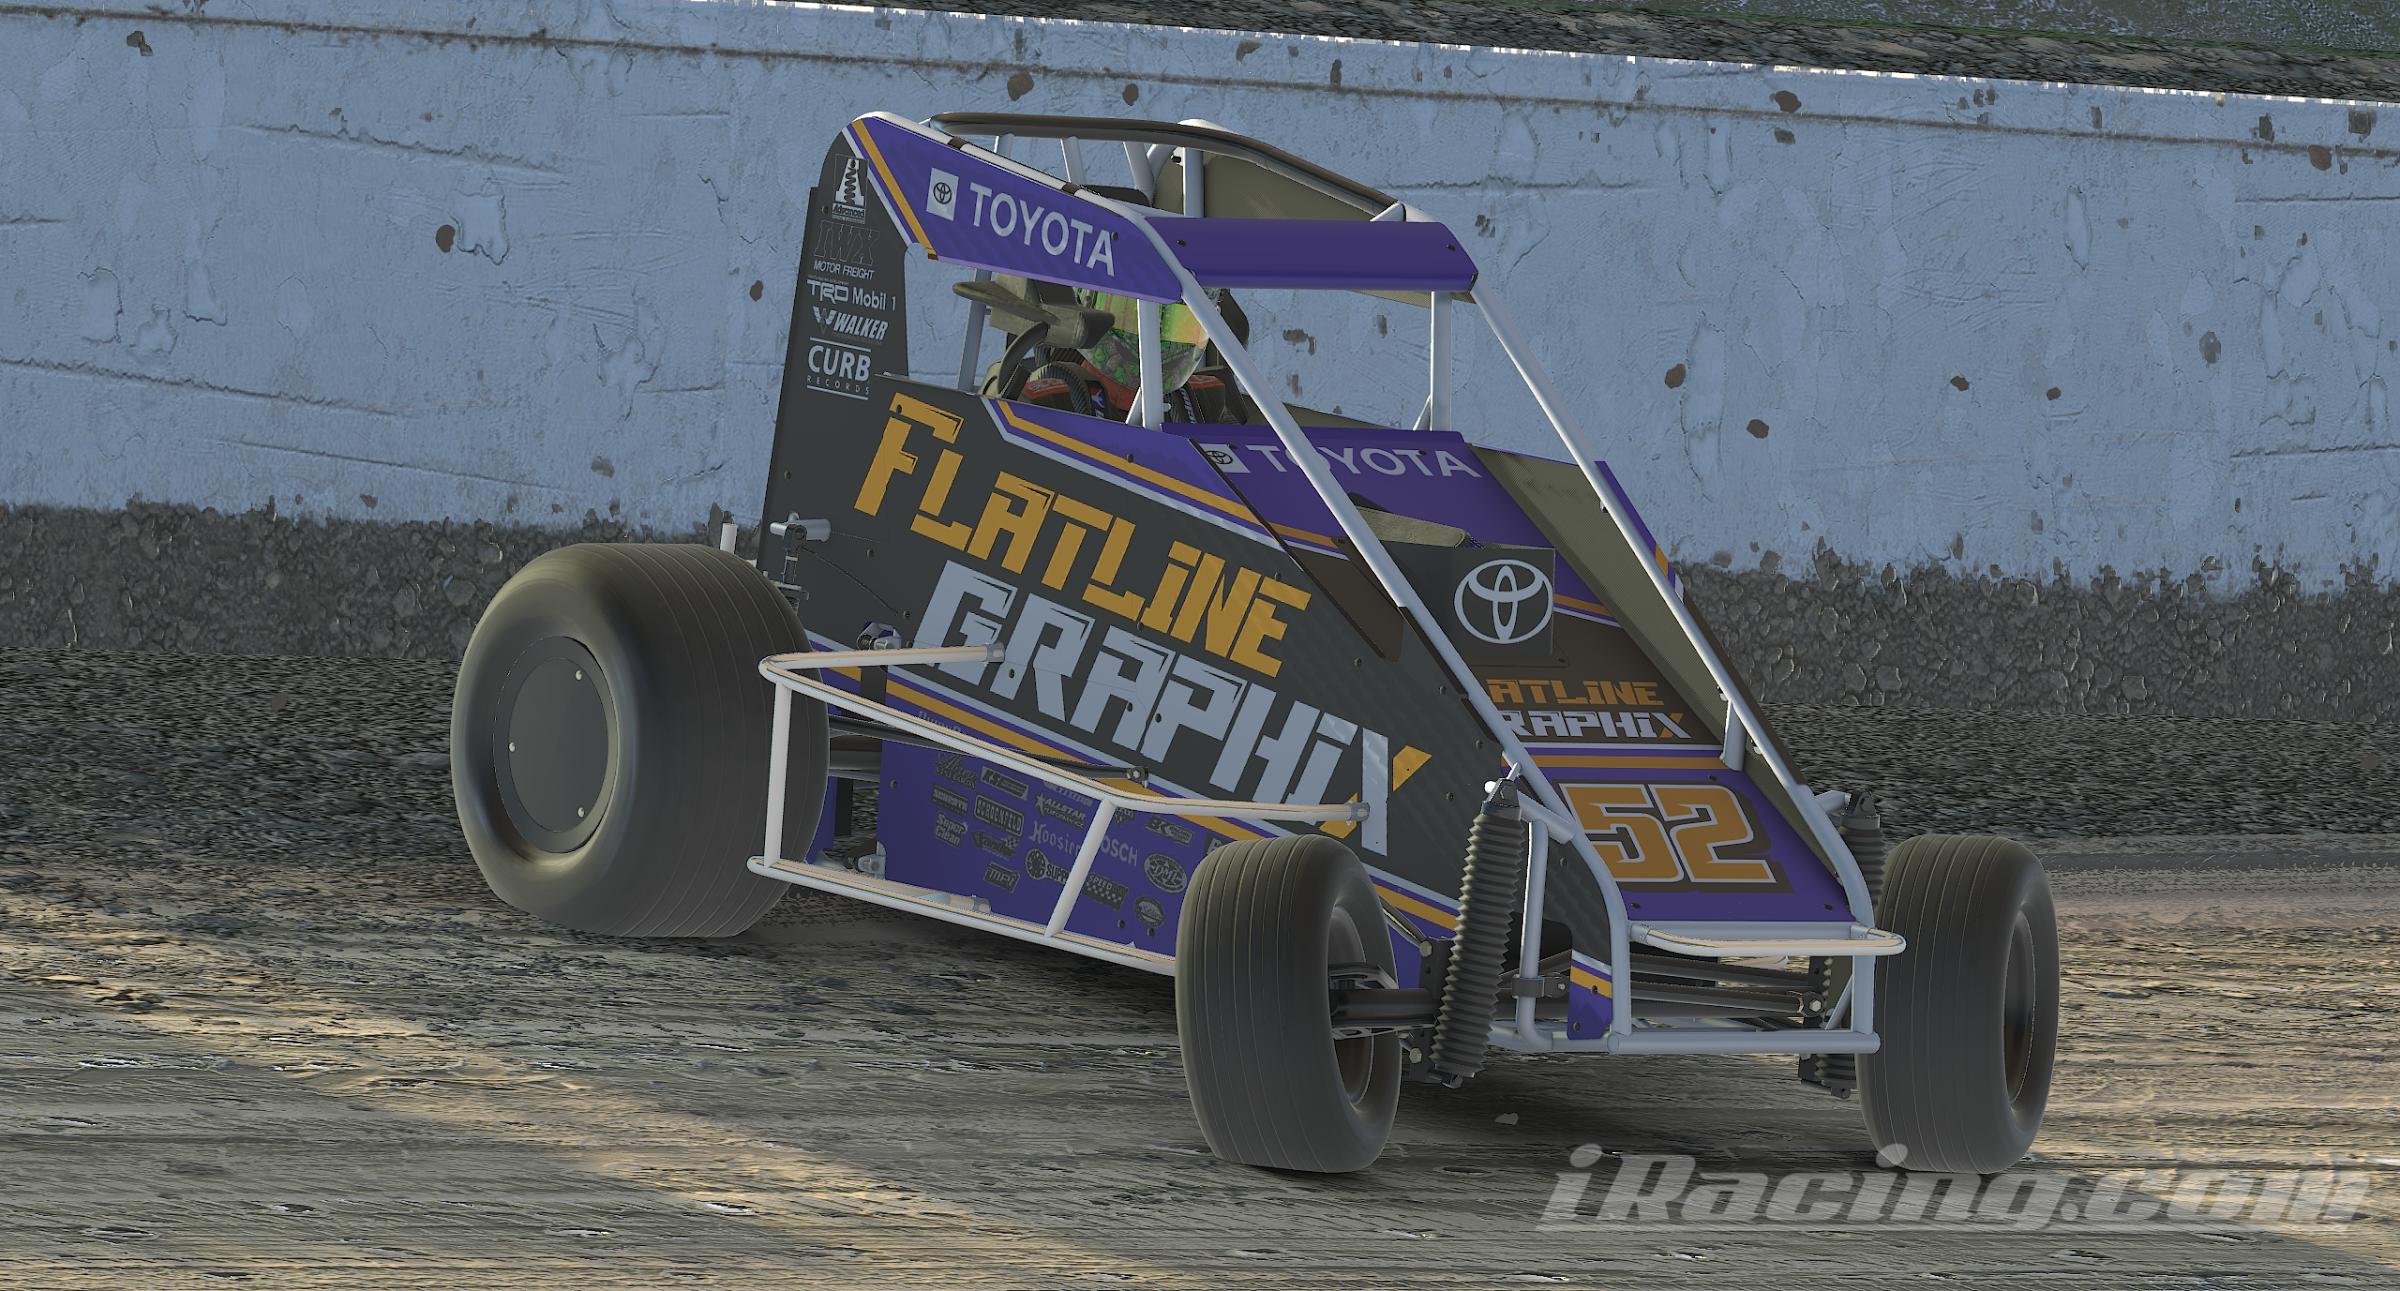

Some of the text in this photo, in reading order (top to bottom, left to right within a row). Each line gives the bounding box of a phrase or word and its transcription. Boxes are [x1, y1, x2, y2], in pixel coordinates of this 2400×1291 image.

[832, 204, 865, 219] Advanced
[969, 182, 1115, 276] TOYOTA
[813, 260, 841, 274] MOTOR
[843, 264, 875, 281] FREIGHT
[852, 286, 887, 311] Mobil
[886, 296, 896, 312] 1
[833, 312, 889, 341] WALKER
[808, 345, 871, 382] CURB
[806, 374, 870, 396] RECORDS
[1486, 679, 1665, 705] ATLINE
[1044, 798, 1086, 820] ALLSTAR
[935, 825, 960, 847] Clean
[1559, 783, 1776, 882] 52
[1099, 833, 1138, 867] OSCH
